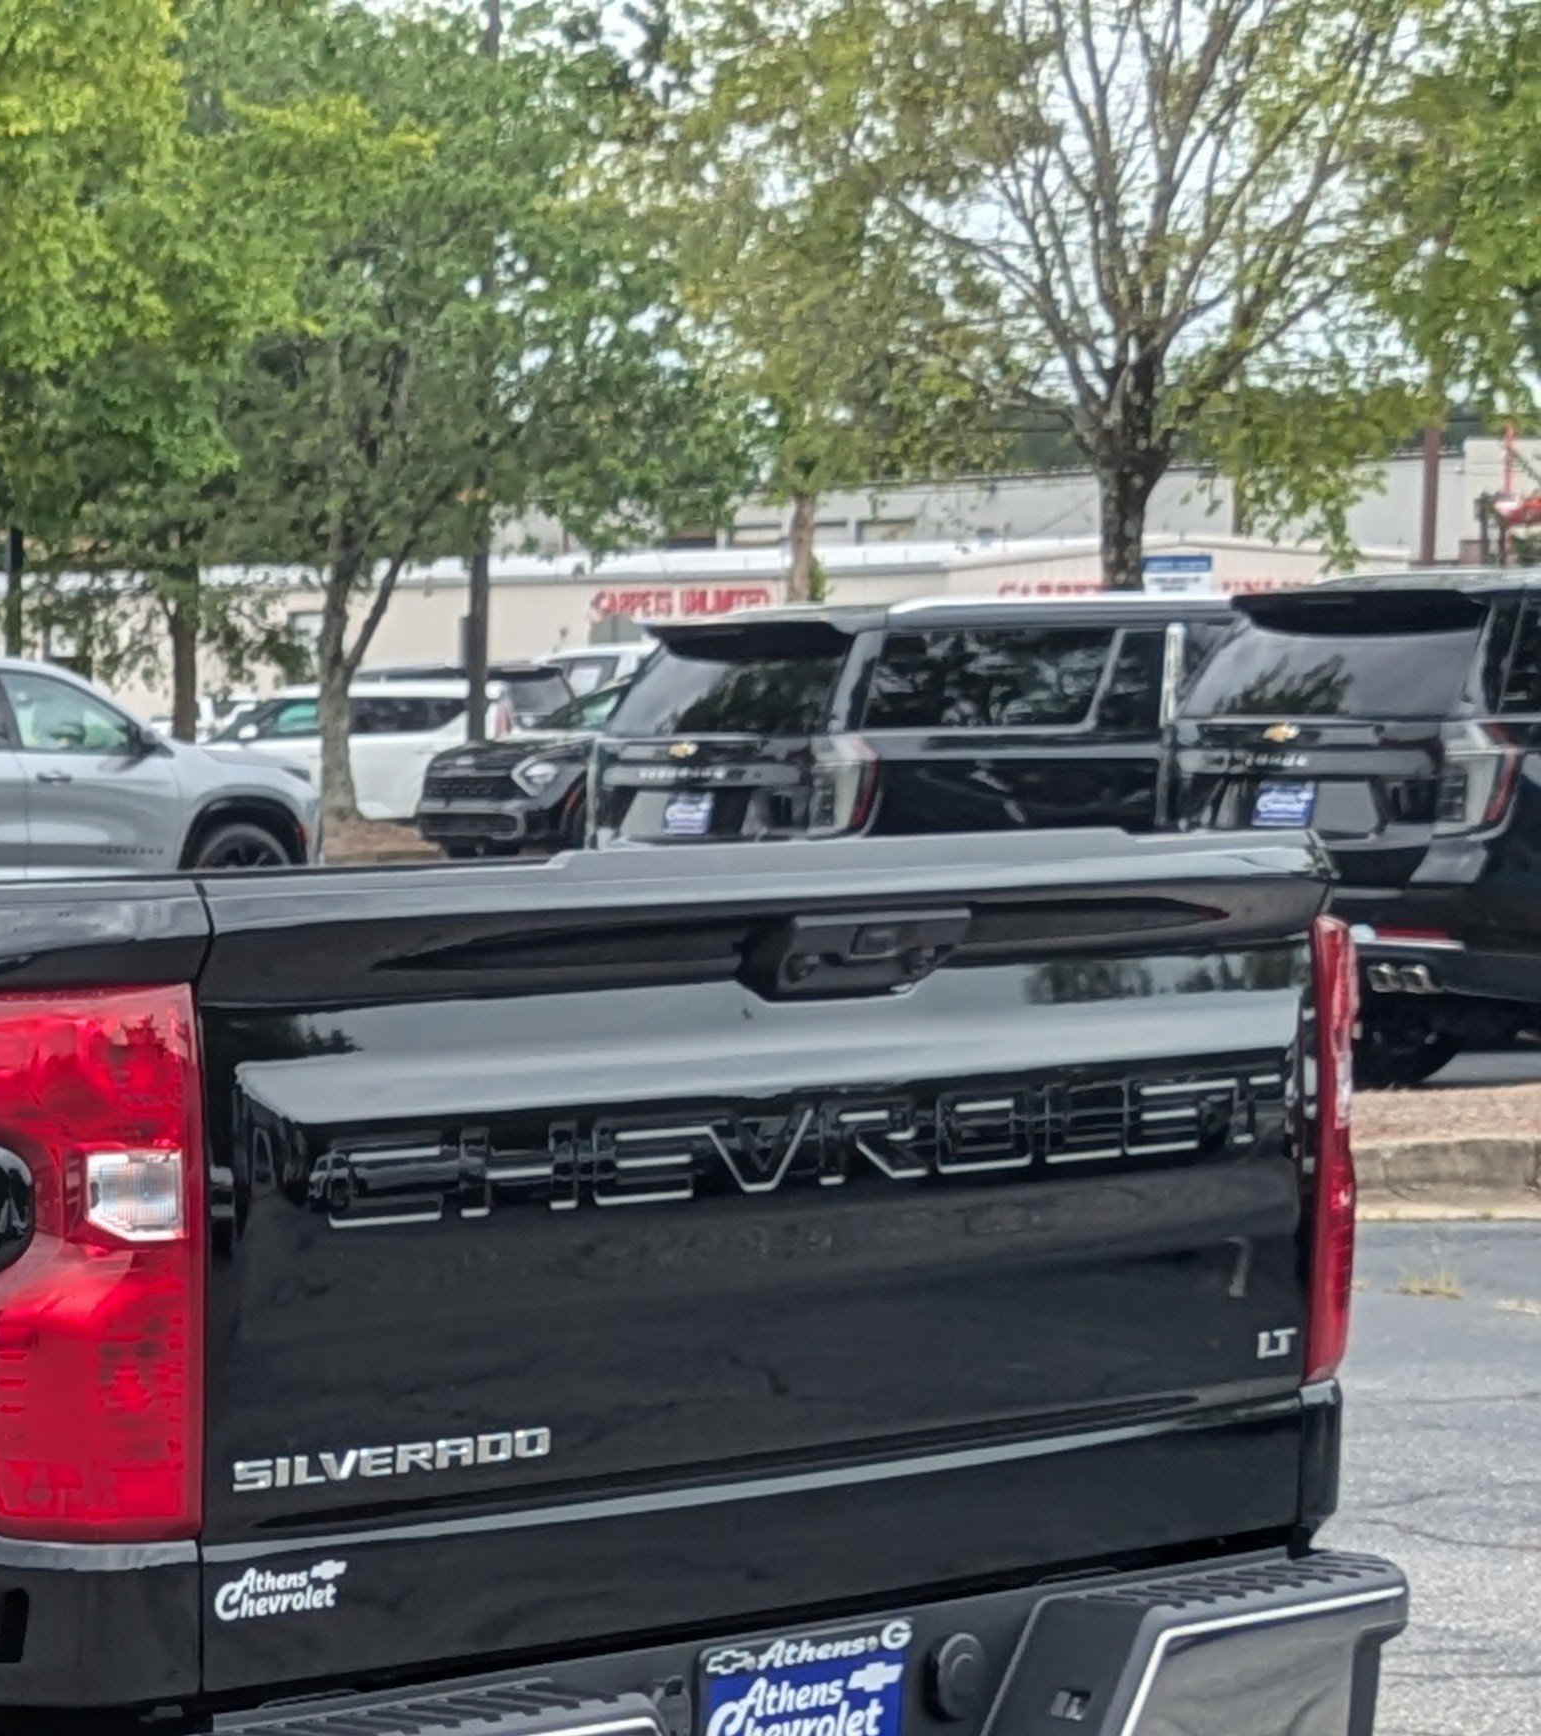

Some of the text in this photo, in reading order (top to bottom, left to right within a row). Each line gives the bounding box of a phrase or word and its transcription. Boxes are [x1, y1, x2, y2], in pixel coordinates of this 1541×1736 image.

[313, 1066, 1284, 1229] CHEVROLET
[1257, 1327, 1299, 1359] LT
[232, 1426, 551, 1492] SILVERADO
[236, 1567, 308, 1595] Athens
[215, 1582, 337, 1621] Chevrolet
[756, 1637, 867, 1670] Athens
[735, 1677, 844, 1718] Athens
